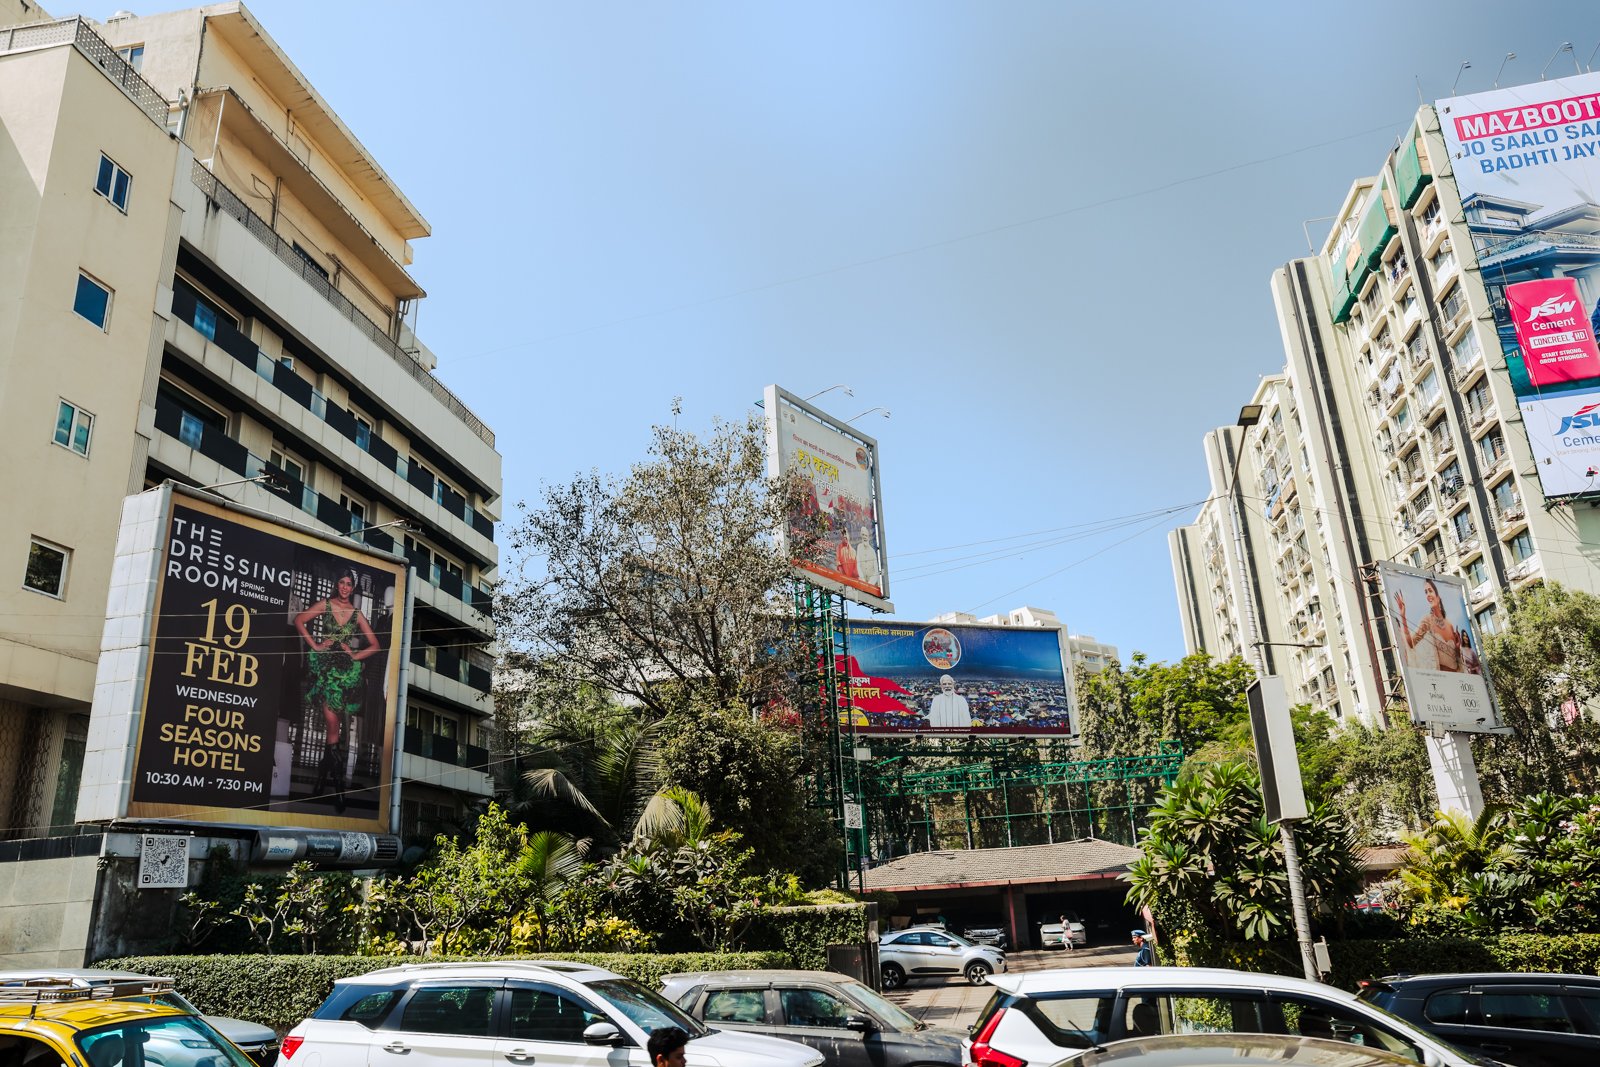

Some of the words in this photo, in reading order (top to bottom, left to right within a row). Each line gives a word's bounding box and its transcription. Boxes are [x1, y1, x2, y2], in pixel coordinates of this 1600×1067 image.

[1460, 96, 1600, 138] MAZBOOT
[1461, 140, 1486, 157] JO
[1491, 128, 1559, 152] SAALO
[1479, 148, 1558, 174] BADHTI
[1562, 140, 1600, 161] JAY
[1523, 298, 1577, 323] JSW
[1531, 317, 1577, 331] Cement
[1532, 334, 1571, 347] CONCREEL
[1574, 331, 1586, 341] HD
[1541, 351, 1559, 359] START
[173, 517, 222, 546] THE
[170, 539, 291, 587] DRESSING
[167, 560, 238, 594] ROOM
[240, 581, 265, 593] SPRING
[239, 589, 269, 603] SUMMER
[269, 597, 285, 606] EDIT
[199, 598, 250, 649] 19
[180, 641, 259, 687] FEB
[176, 684, 258, 708] WEDNESDAY
[184, 704, 245, 730] FOUR
[160, 723, 261, 753] SEASONS
[173, 746, 245, 772] HOTEL
[146, 771, 180, 785] 10:30
[182, 775, 204, 788] AM
[216, 778, 241, 791] 7:30
[243, 781, 263, 793] PM
